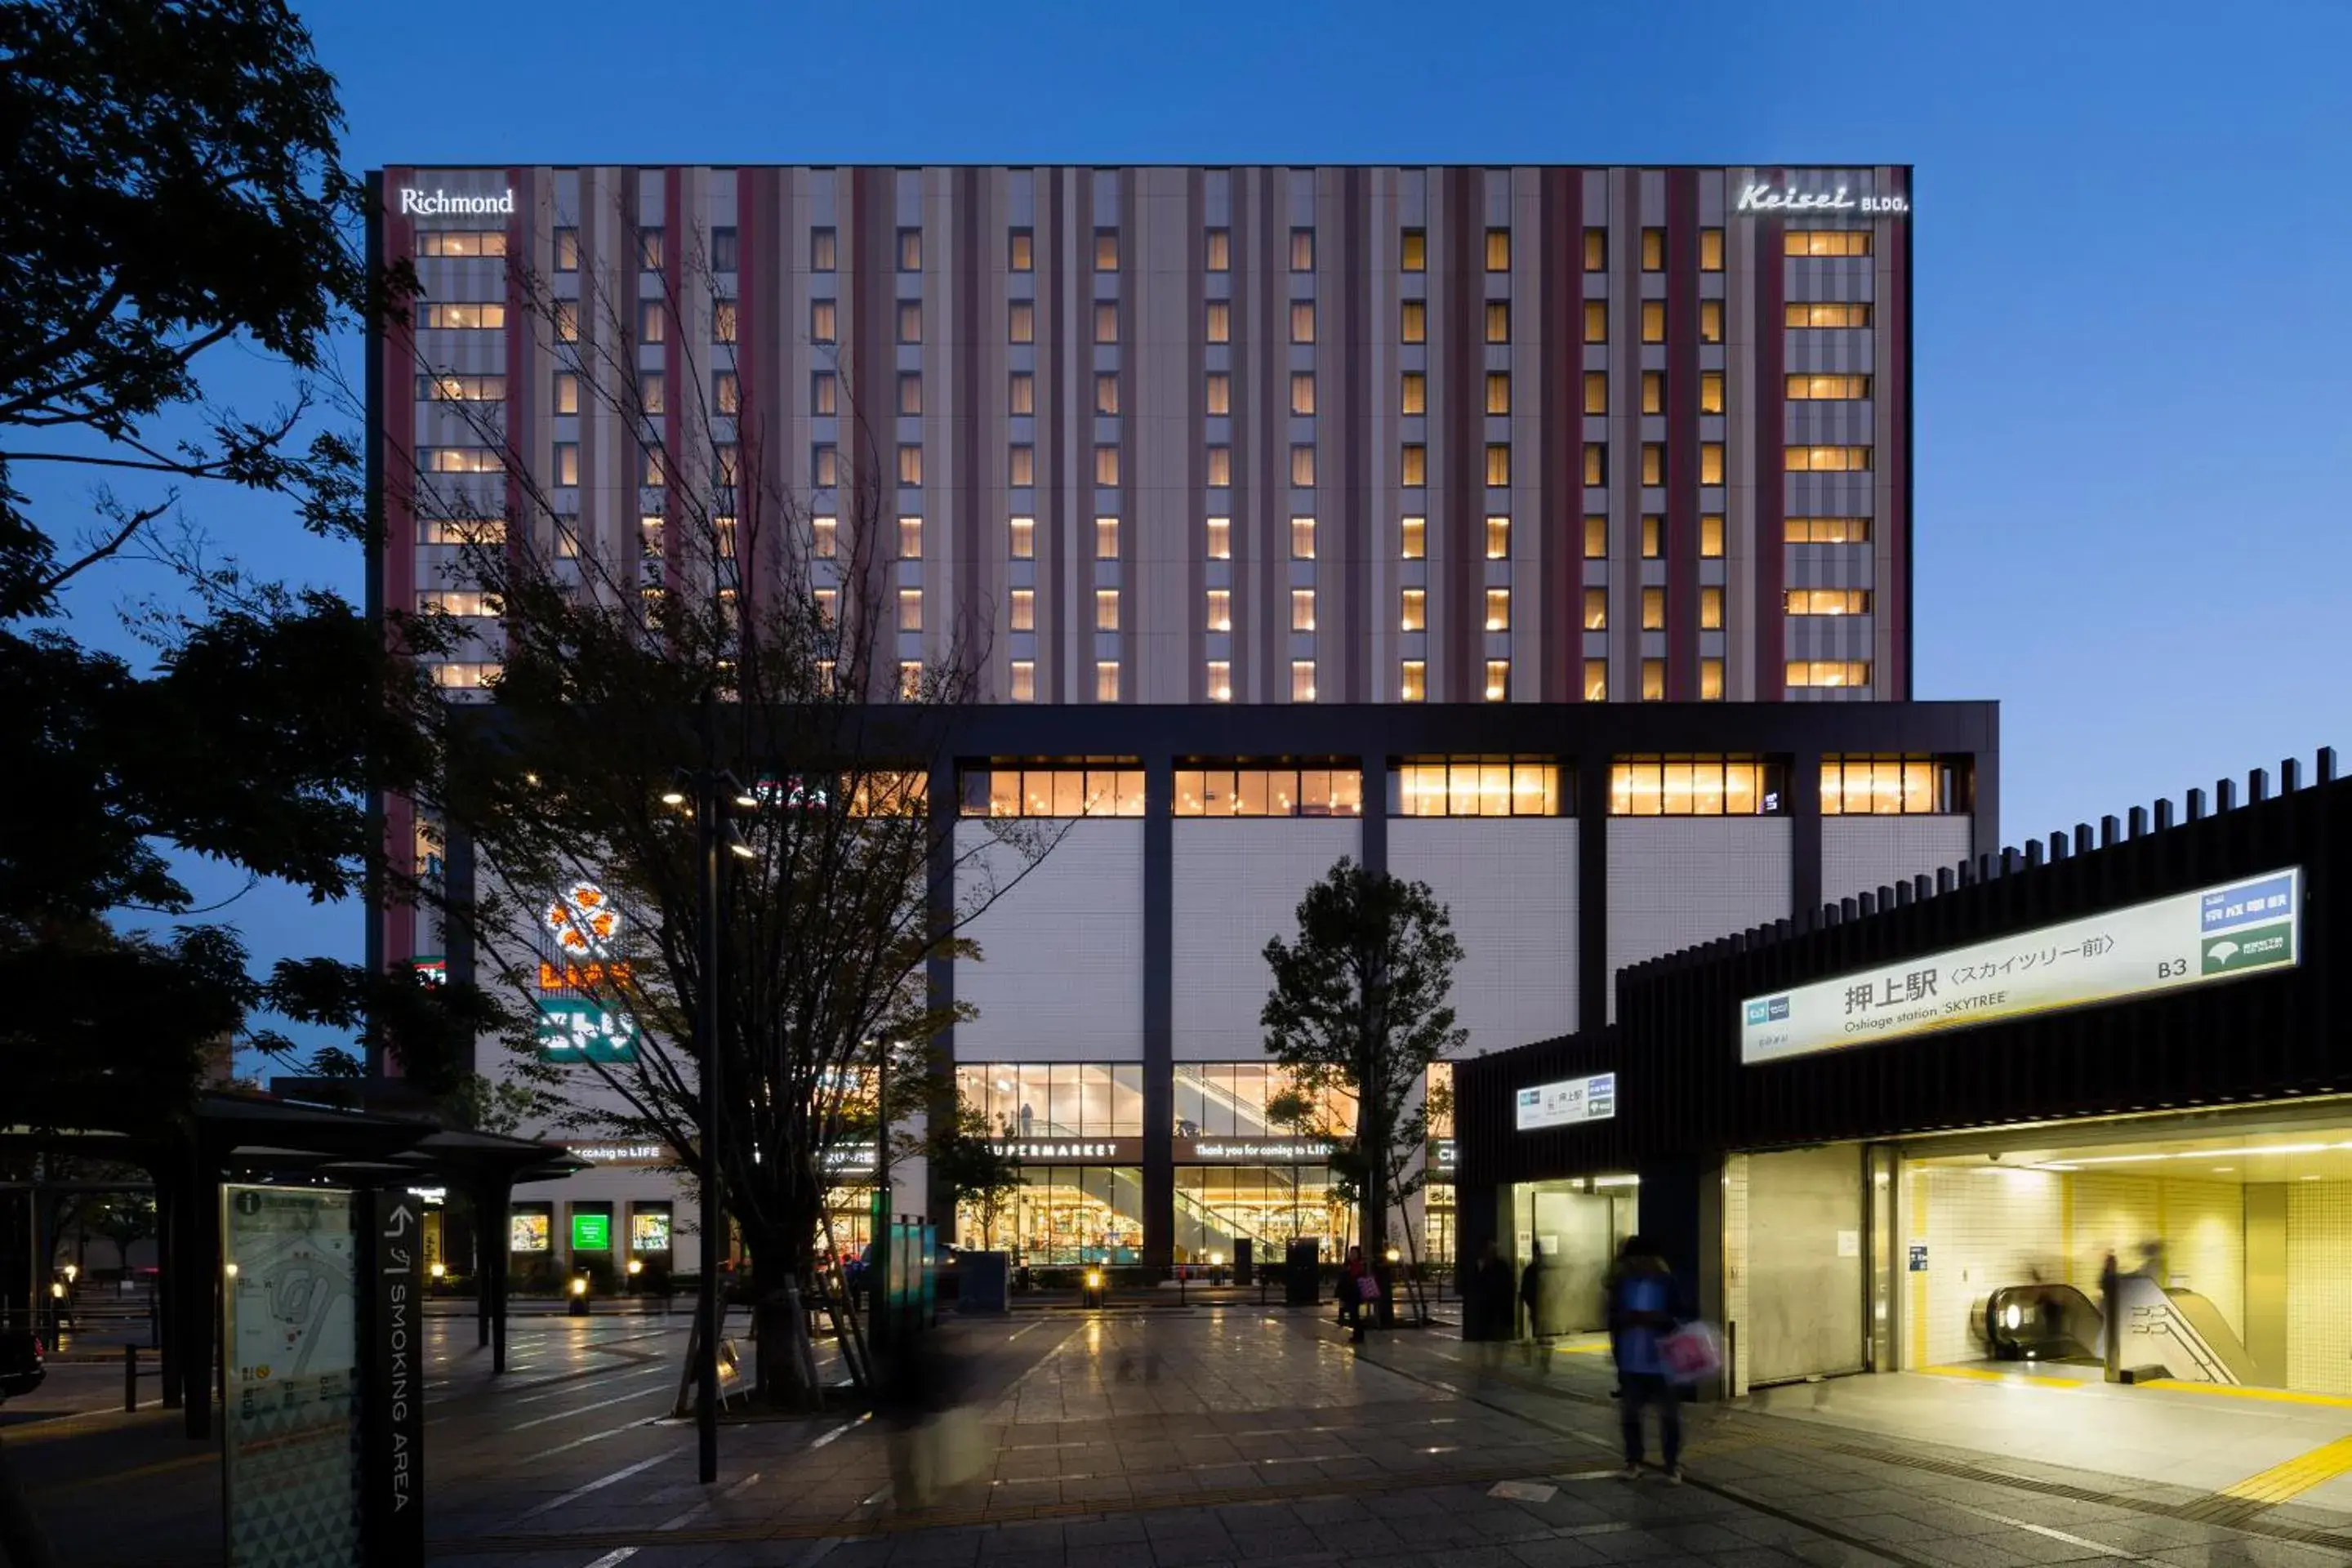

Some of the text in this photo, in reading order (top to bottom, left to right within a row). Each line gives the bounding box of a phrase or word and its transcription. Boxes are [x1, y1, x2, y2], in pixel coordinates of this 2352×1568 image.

[400, 189, 514, 215] Richmond
[1737, 184, 1909, 212] Keisei BLDG.
[2158, 958, 2187, 979] B3
[1845, 968, 1938, 1015] 押上駅
[1844, 1016, 1893, 1033] Oshiage
[1896, 1005, 1938, 1022] station
[630, 1147, 660, 1157] LIFE
[984, 1143, 1116, 1156] UPERMARKET
[1196, 1144, 1224, 1155] Thank
[1225, 1146, 1244, 1157] you
[1245, 1143, 1258, 1155] for
[1260, 1144, 1294, 1157] coming
[1295, 1145, 1305, 1155] to
[390, 1283, 410, 1513] SMOKING AREA
